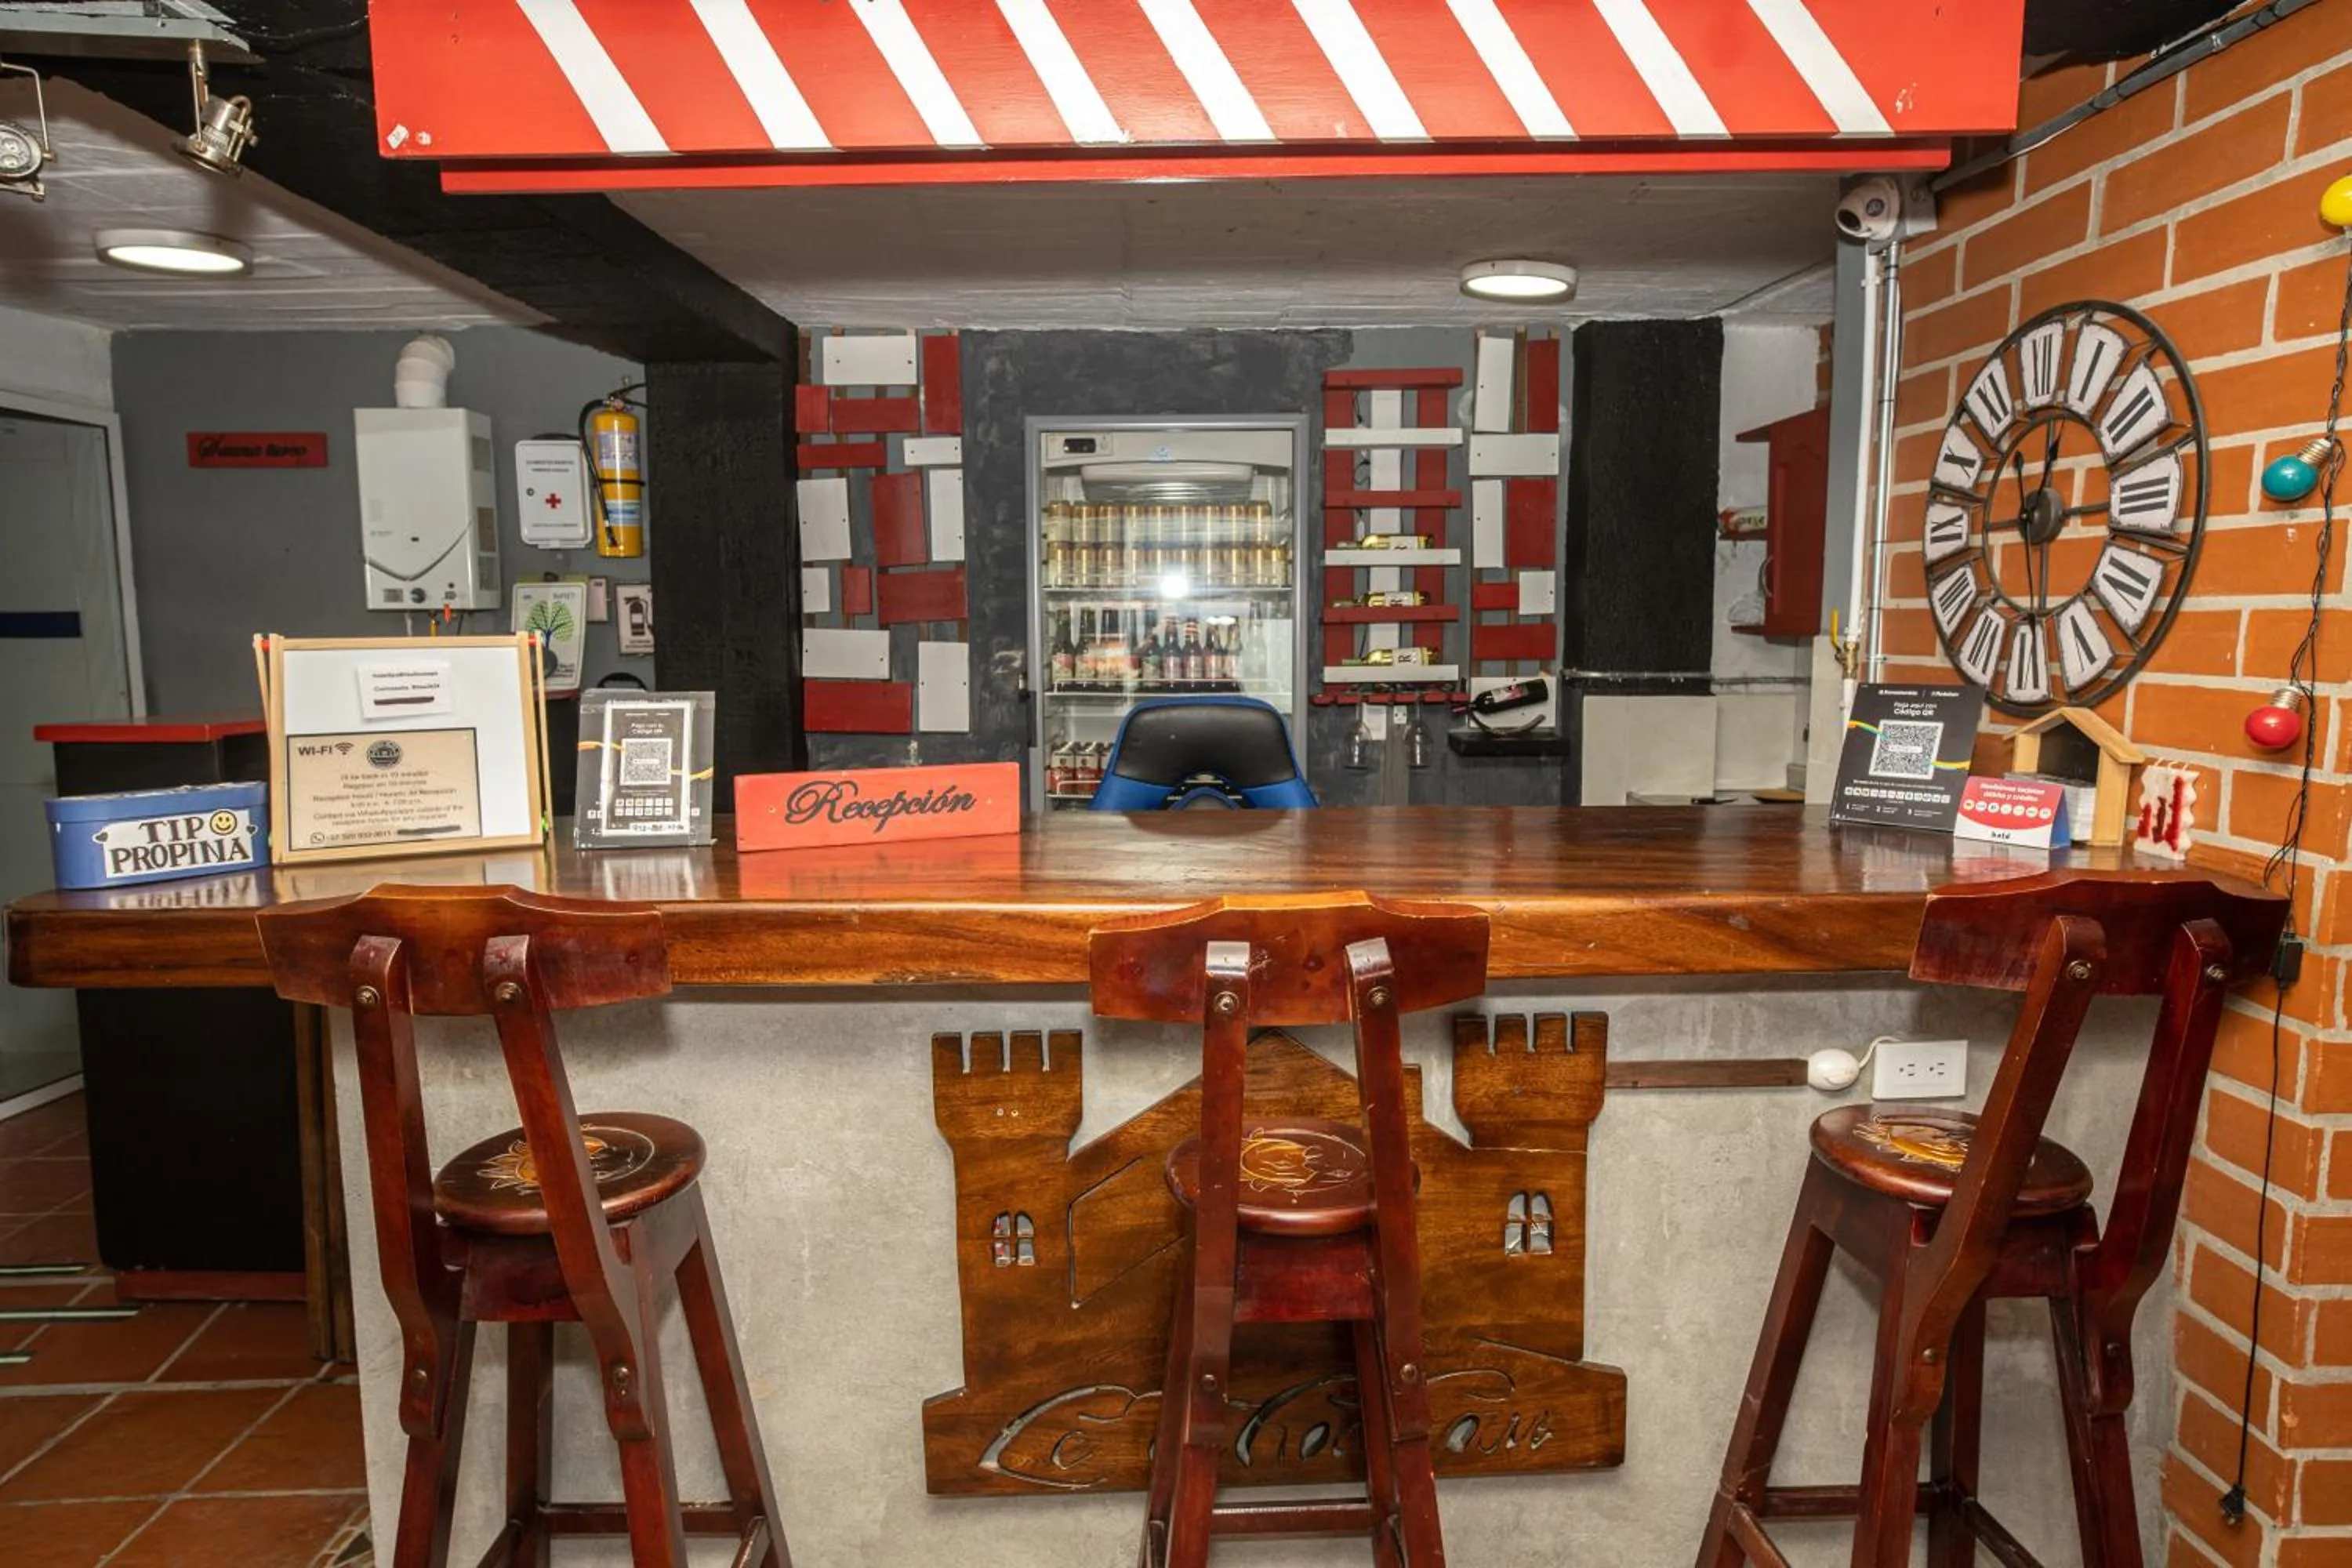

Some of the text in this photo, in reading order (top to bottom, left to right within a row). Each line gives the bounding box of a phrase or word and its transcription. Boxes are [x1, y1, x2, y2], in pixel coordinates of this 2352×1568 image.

[785, 780, 977, 833] Recepción
[139, 816, 204, 844] TIP
[109, 837, 250, 874] PROPINA
